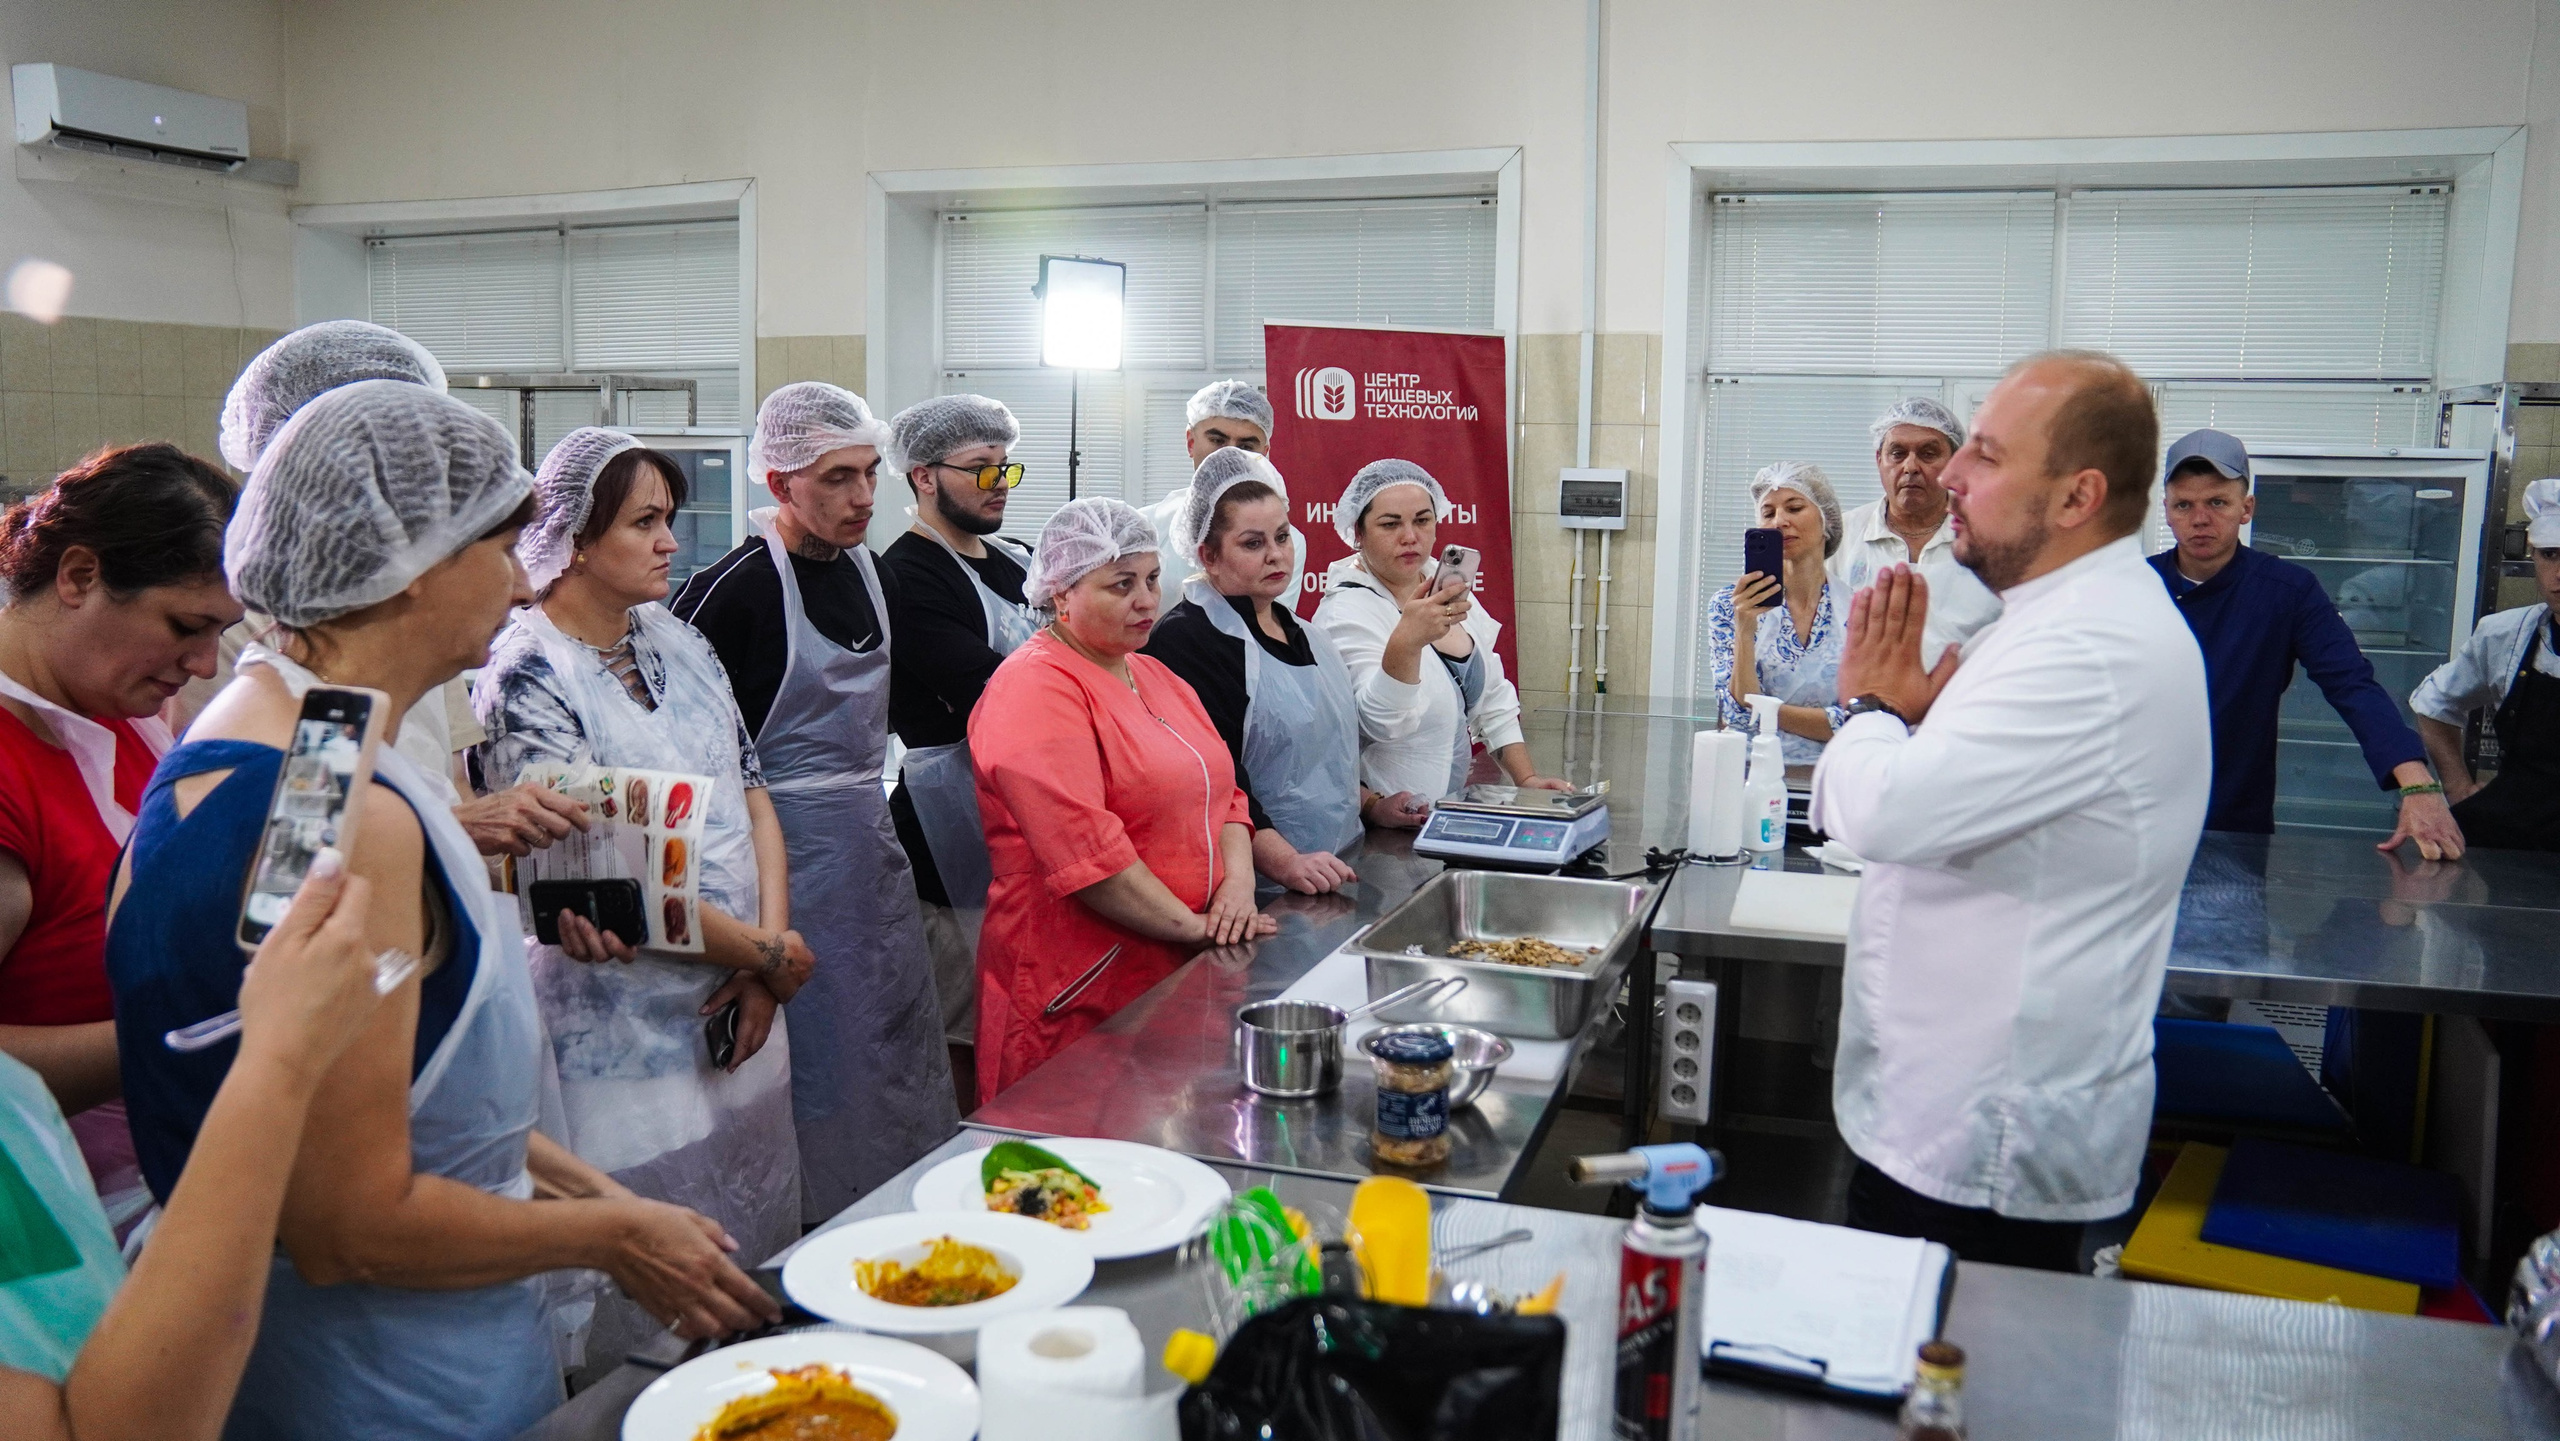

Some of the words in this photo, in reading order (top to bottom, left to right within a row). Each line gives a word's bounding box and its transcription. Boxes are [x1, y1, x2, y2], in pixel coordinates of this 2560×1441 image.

[1364, 372, 1420, 387] ЦЕНТР
[1364, 388, 1453, 404] ПИЩЕВЫХ
[1363, 403, 1478, 420] ТЕХНОЛОГИЙ
